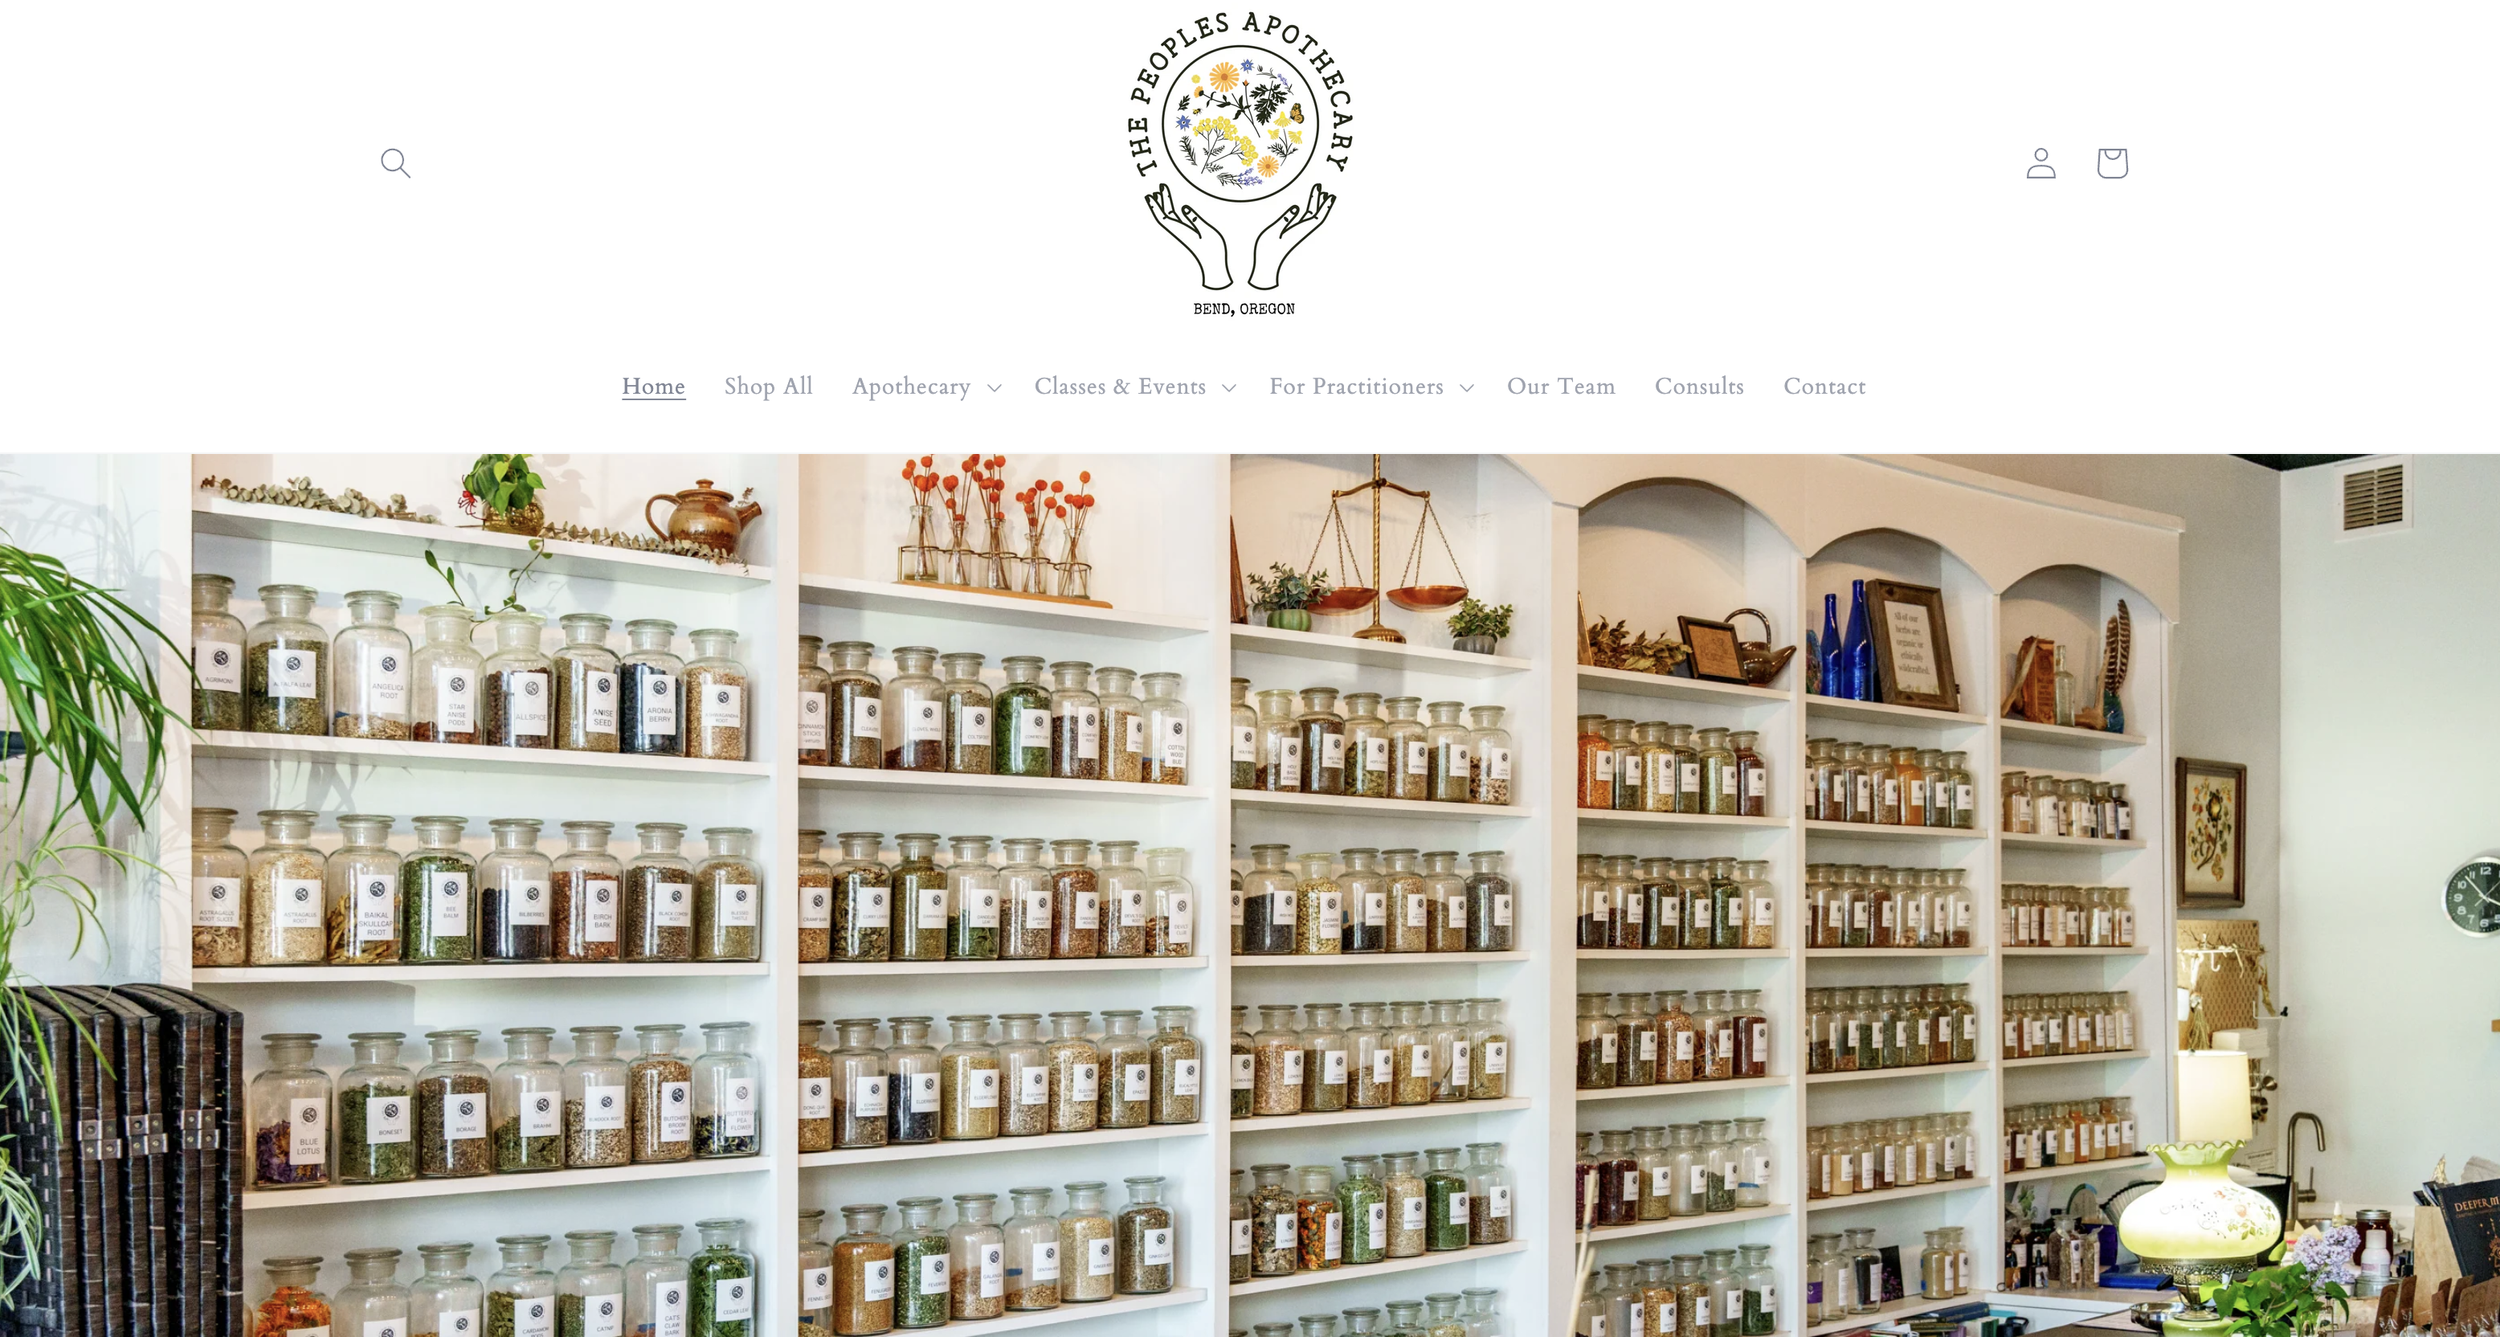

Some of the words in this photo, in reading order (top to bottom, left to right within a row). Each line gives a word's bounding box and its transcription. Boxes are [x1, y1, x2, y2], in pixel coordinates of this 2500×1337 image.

[1130, 11, 1229, 106] PEOPLES
[1242, 11, 1354, 173] APOTHECARY
[1127, 117, 1157, 178] THE
[1193, 302, 1236, 318] BEND,
[1239, 302, 1296, 315] OREGON
[622, 378, 686, 395] Home
[725, 375, 774, 401] Shop
[783, 375, 812, 394] All
[852, 375, 970, 401] Apothecary
[1035, 375, 1105, 394] Classes
[1114, 379, 1130, 394] &
[1138, 378, 1205, 394] Events
[1271, 378, 1305, 394] For
[1313, 378, 1443, 394] Practitioners
[1508, 377, 1549, 394] Our
[1558, 378, 1615, 394] Team
[1656, 375, 1743, 394] Consults
[1785, 377, 1865, 394] Contact
[1896, 624, 1911, 635] herbs
[205, 677, 234, 685] AGRIMONY
[593, 709, 613, 718] ANISE
[647, 707, 672, 715] ARONIA
[515, 713, 547, 721] ALLSPICE
[649, 715, 671, 723] BERRY
[594, 718, 612, 727] SEED
[2469, 871, 2475, 879] 11
[2480, 867, 2491, 875] 12
[2458, 881, 2466, 889] 10
[2454, 894, 2463, 902] 9
[2457, 906, 2466, 914] 8
[2467, 915, 2475, 923] 7
[2480, 919, 2489, 927] 6
[359, 920, 393, 928] SKULLCAP
[300, 1138, 318, 1146] BLUE
[297, 1147, 320, 1155] LOTUS
[2454, 1198, 2491, 1212] DEEPER
